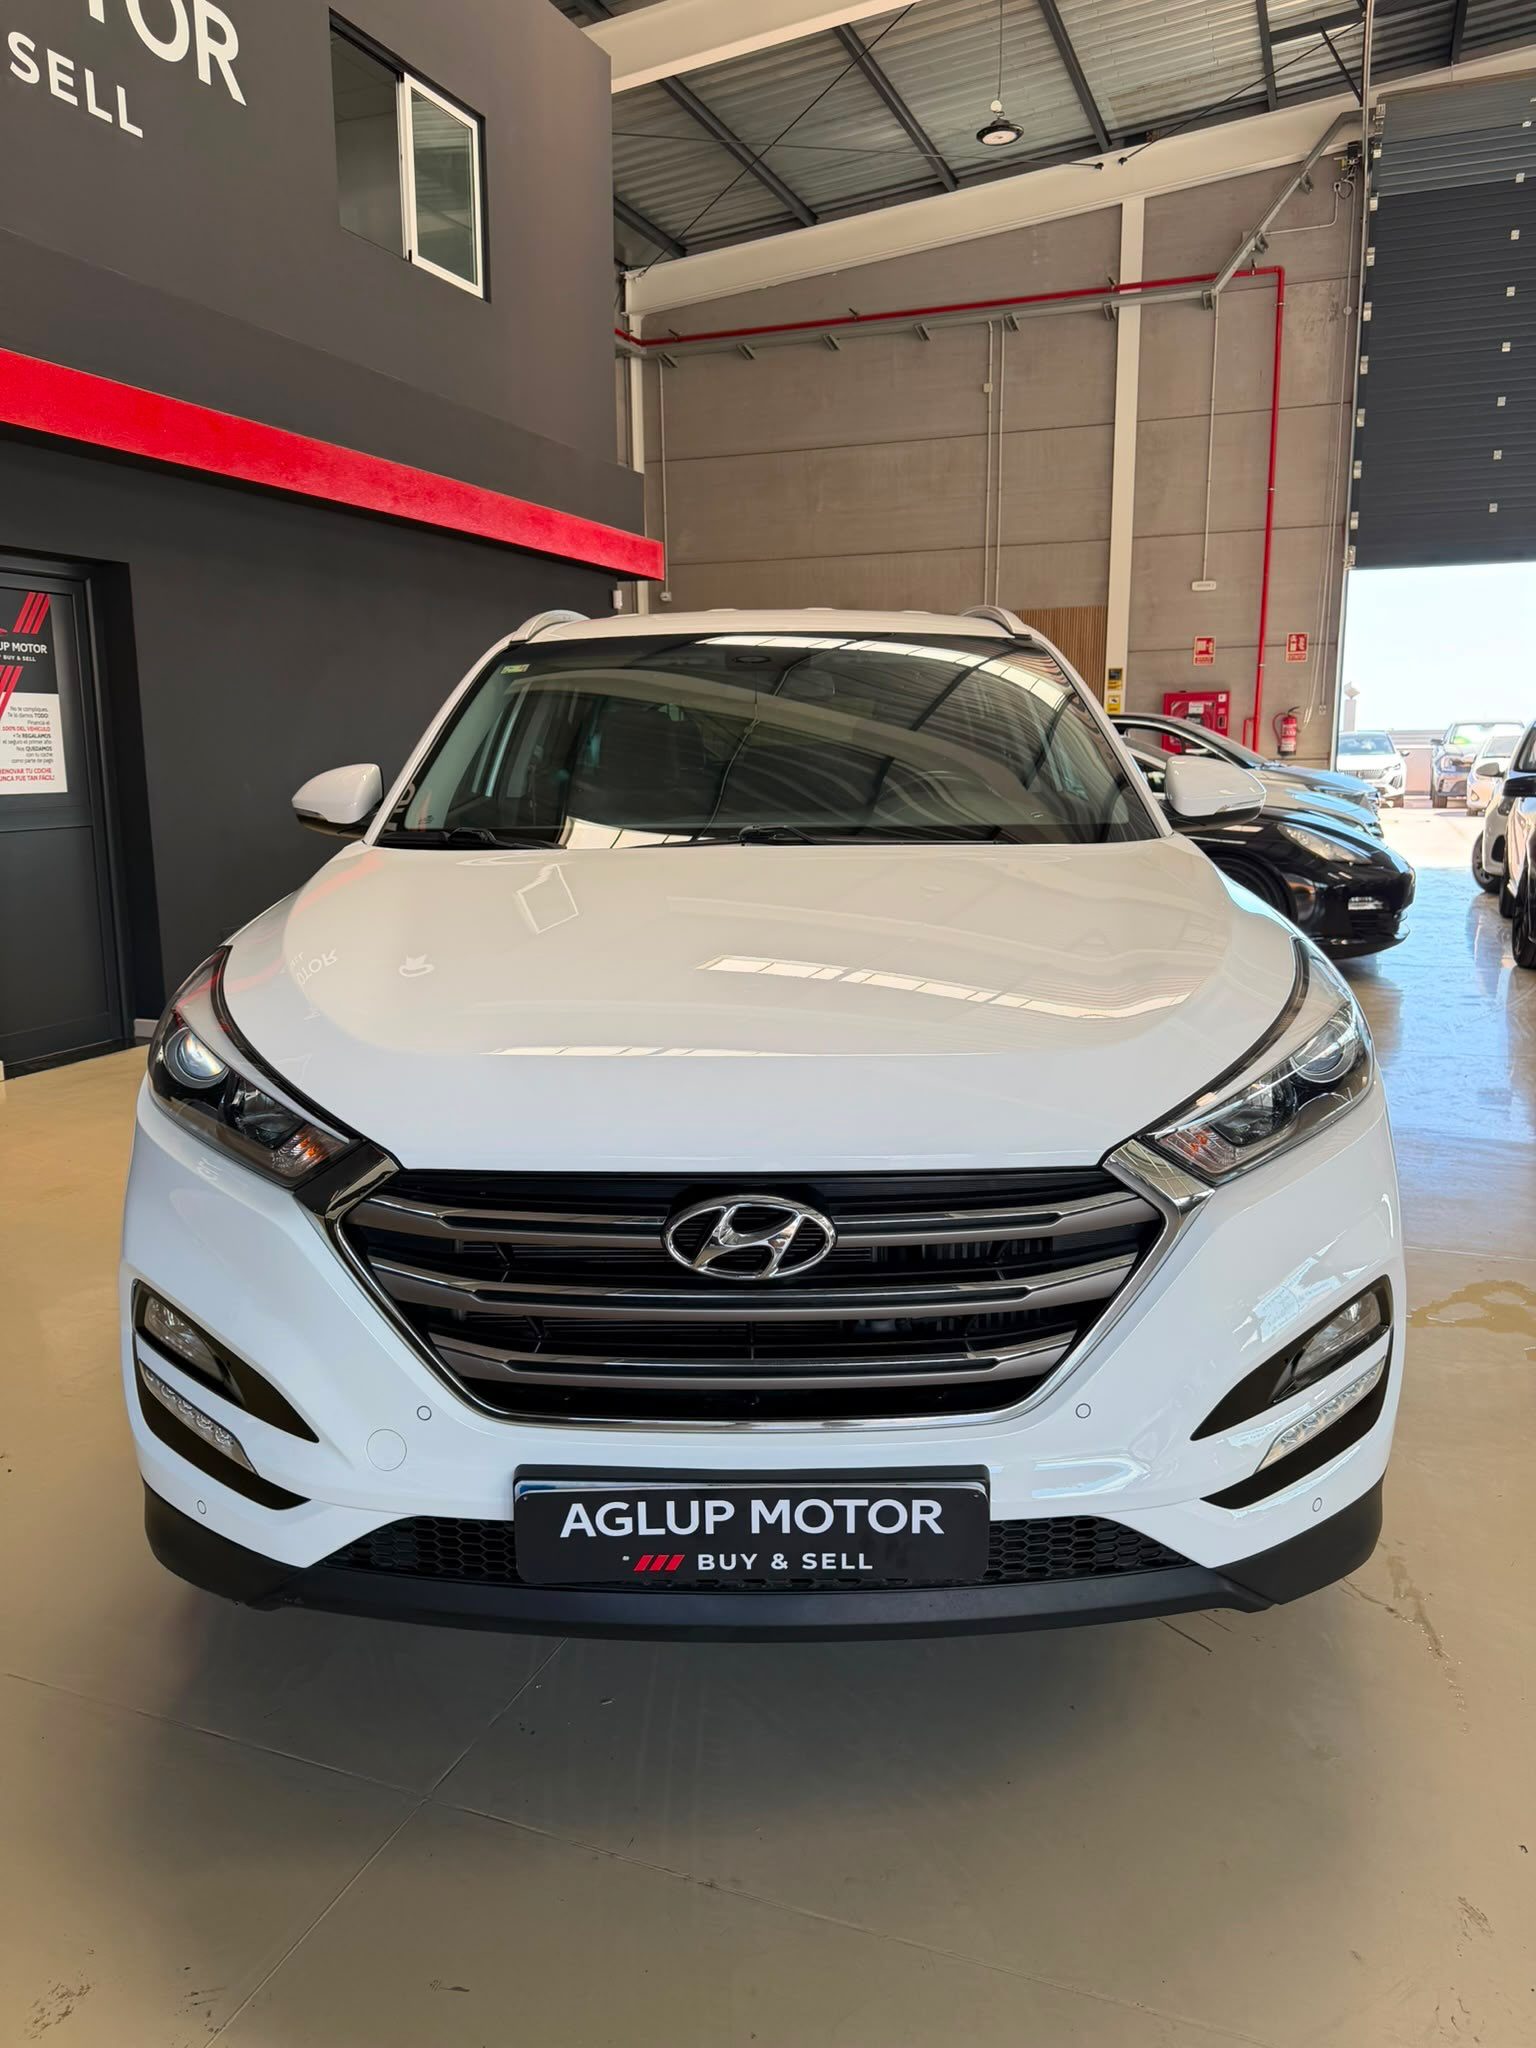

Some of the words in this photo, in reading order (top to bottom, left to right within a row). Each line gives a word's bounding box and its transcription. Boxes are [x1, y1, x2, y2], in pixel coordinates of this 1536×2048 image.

[89, 0, 247, 106] OR
[7, 31, 143, 138] SELL
[12, 642, 47, 654] MOTOR
[559, 1500, 735, 1538] AGLUP
[750, 1499, 945, 1535] MOTOR
[697, 1553, 758, 1571] BUY
[770, 1552, 789, 1570] &
[802, 1552, 873, 1570] SELL
